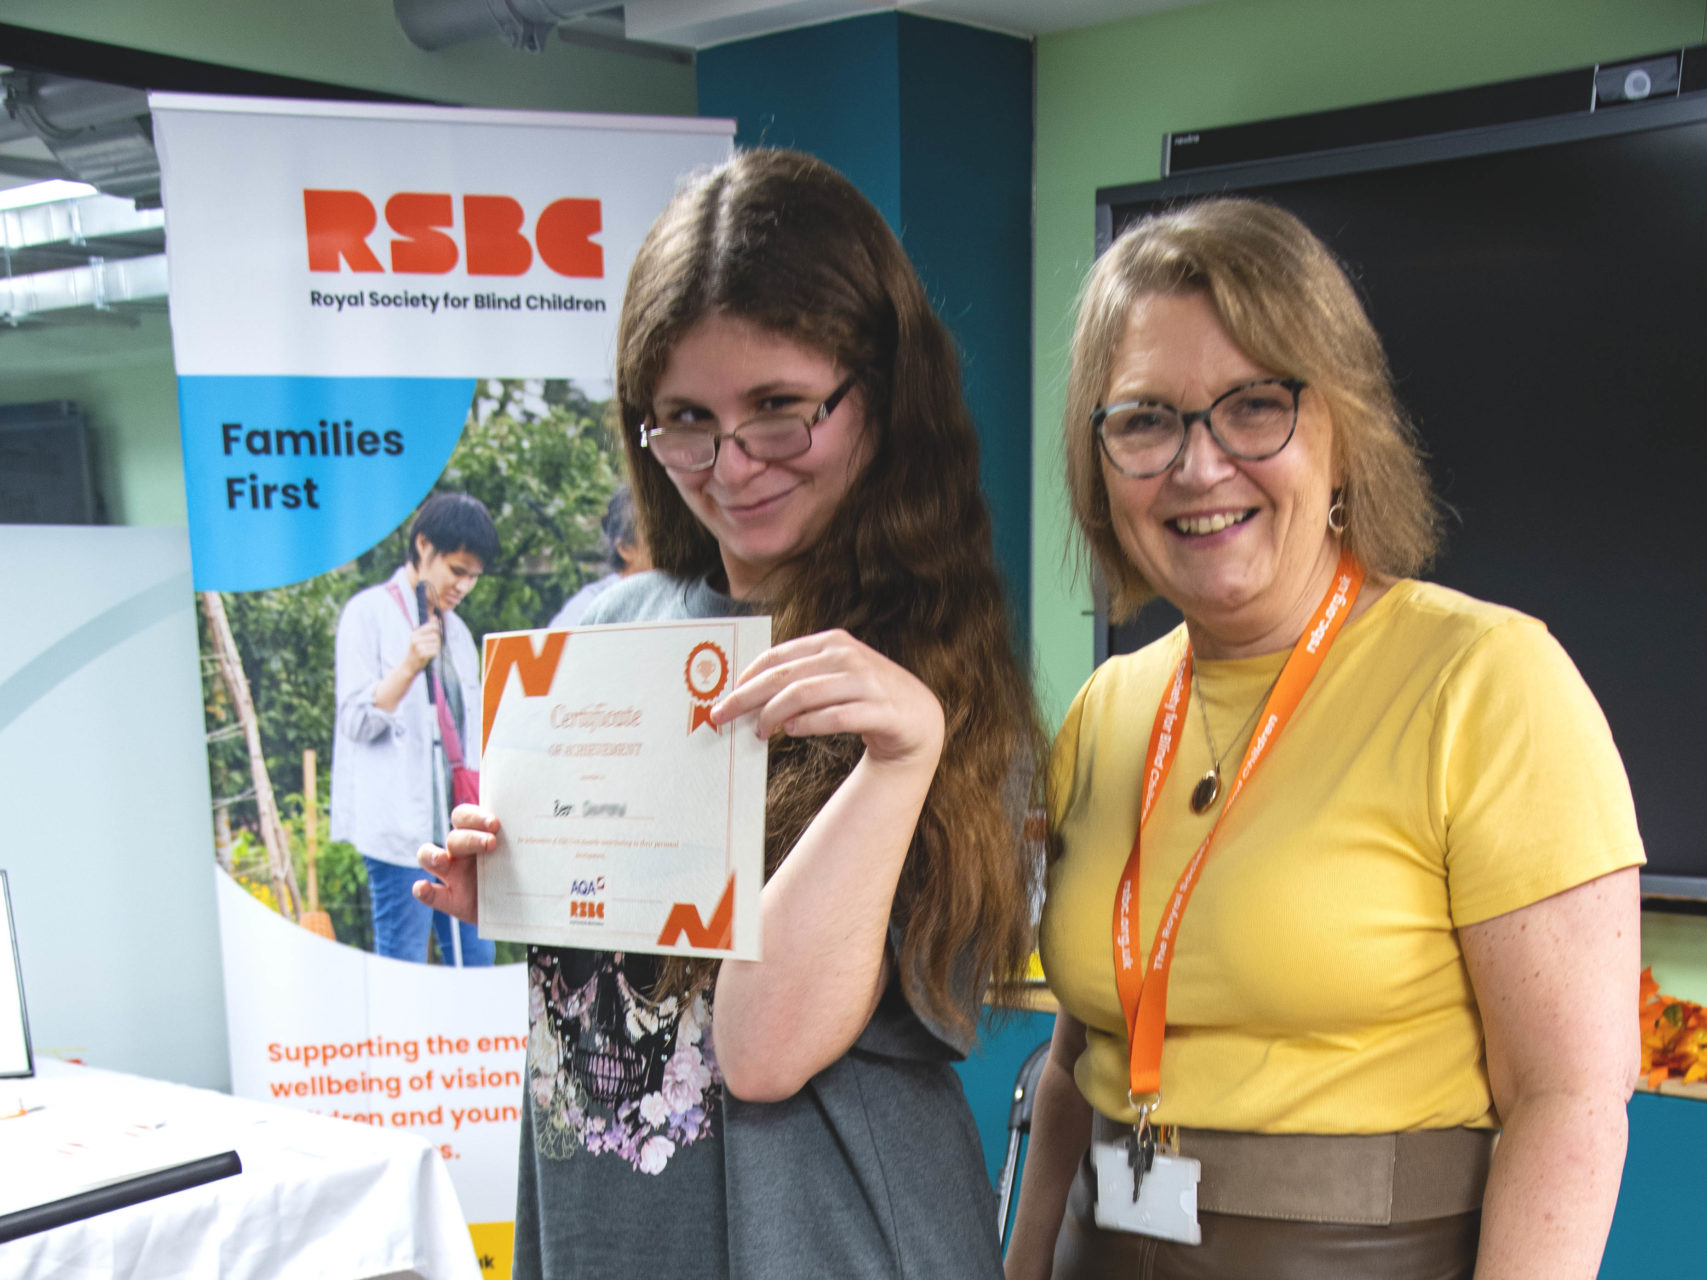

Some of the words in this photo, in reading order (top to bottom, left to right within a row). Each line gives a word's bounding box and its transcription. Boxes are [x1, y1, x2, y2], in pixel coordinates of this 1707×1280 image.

[303, 188, 604, 279] RSBC
[310, 290, 364, 311] Royal
[369, 290, 439, 313] Society
[443, 291, 469, 309] for
[474, 292, 520, 310] Blind
[526, 293, 606, 312] Children
[221, 419, 404, 456] Families
[226, 473, 319, 509] First
[1306, 574, 1352, 654] rsbc.org.uk
[1165, 660, 1187, 713] Society
[1163, 712, 1179, 733] for
[1153, 732, 1172, 770] Blind
[570, 880, 596, 896] AQA
[268, 1036, 419, 1067] Supporting
[427, 1034, 469, 1055] the
[270, 1072, 400, 1099] wellbeing
[409, 1070, 433, 1091] of
[441, 1066, 520, 1090] vision
[391, 1106, 443, 1126] and
[450, 1105, 523, 1131] youn
